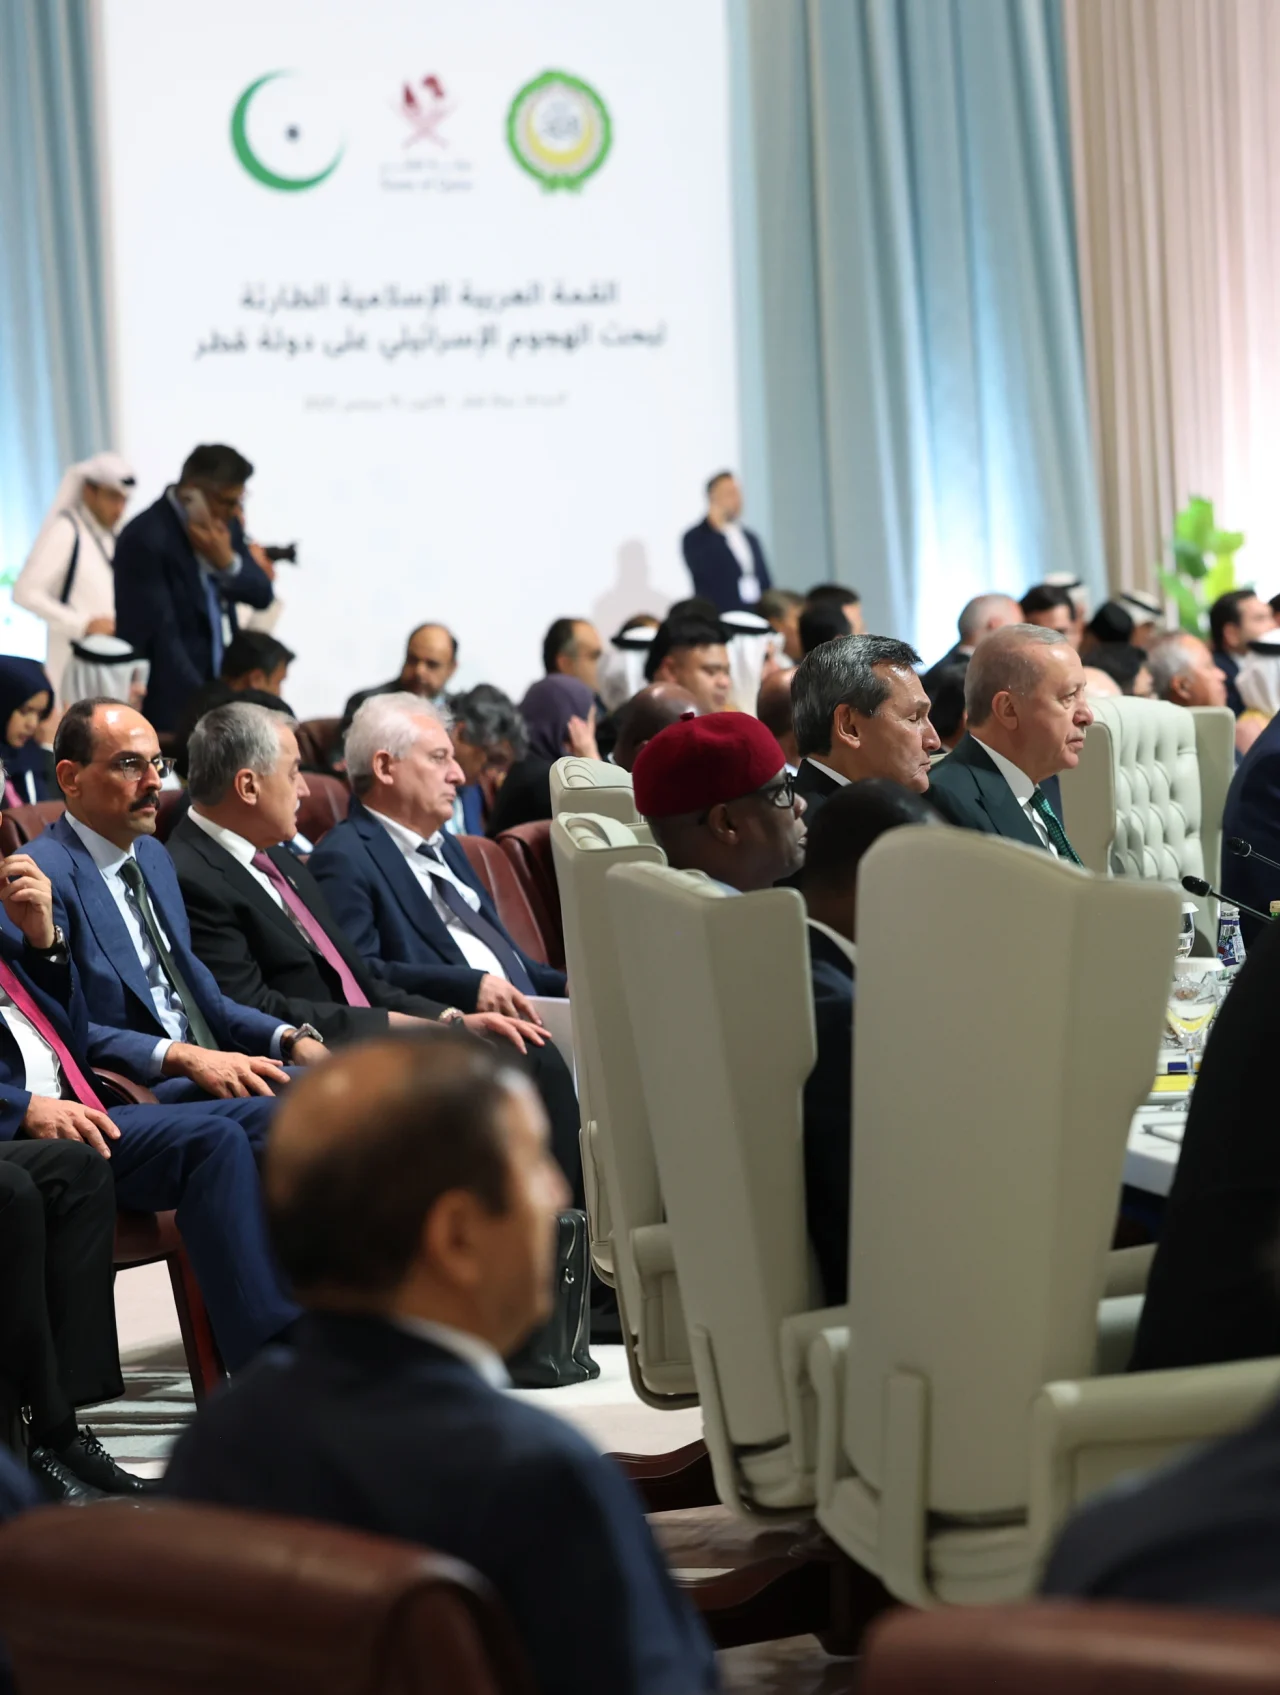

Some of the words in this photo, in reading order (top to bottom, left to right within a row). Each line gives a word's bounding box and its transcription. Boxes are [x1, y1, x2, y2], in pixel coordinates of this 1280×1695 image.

[461, 280, 543, 313] العربية
[194, 328, 247, 360] قطر
[323, 325, 367, 358] على
[507, 322, 591, 358] الهجوم
